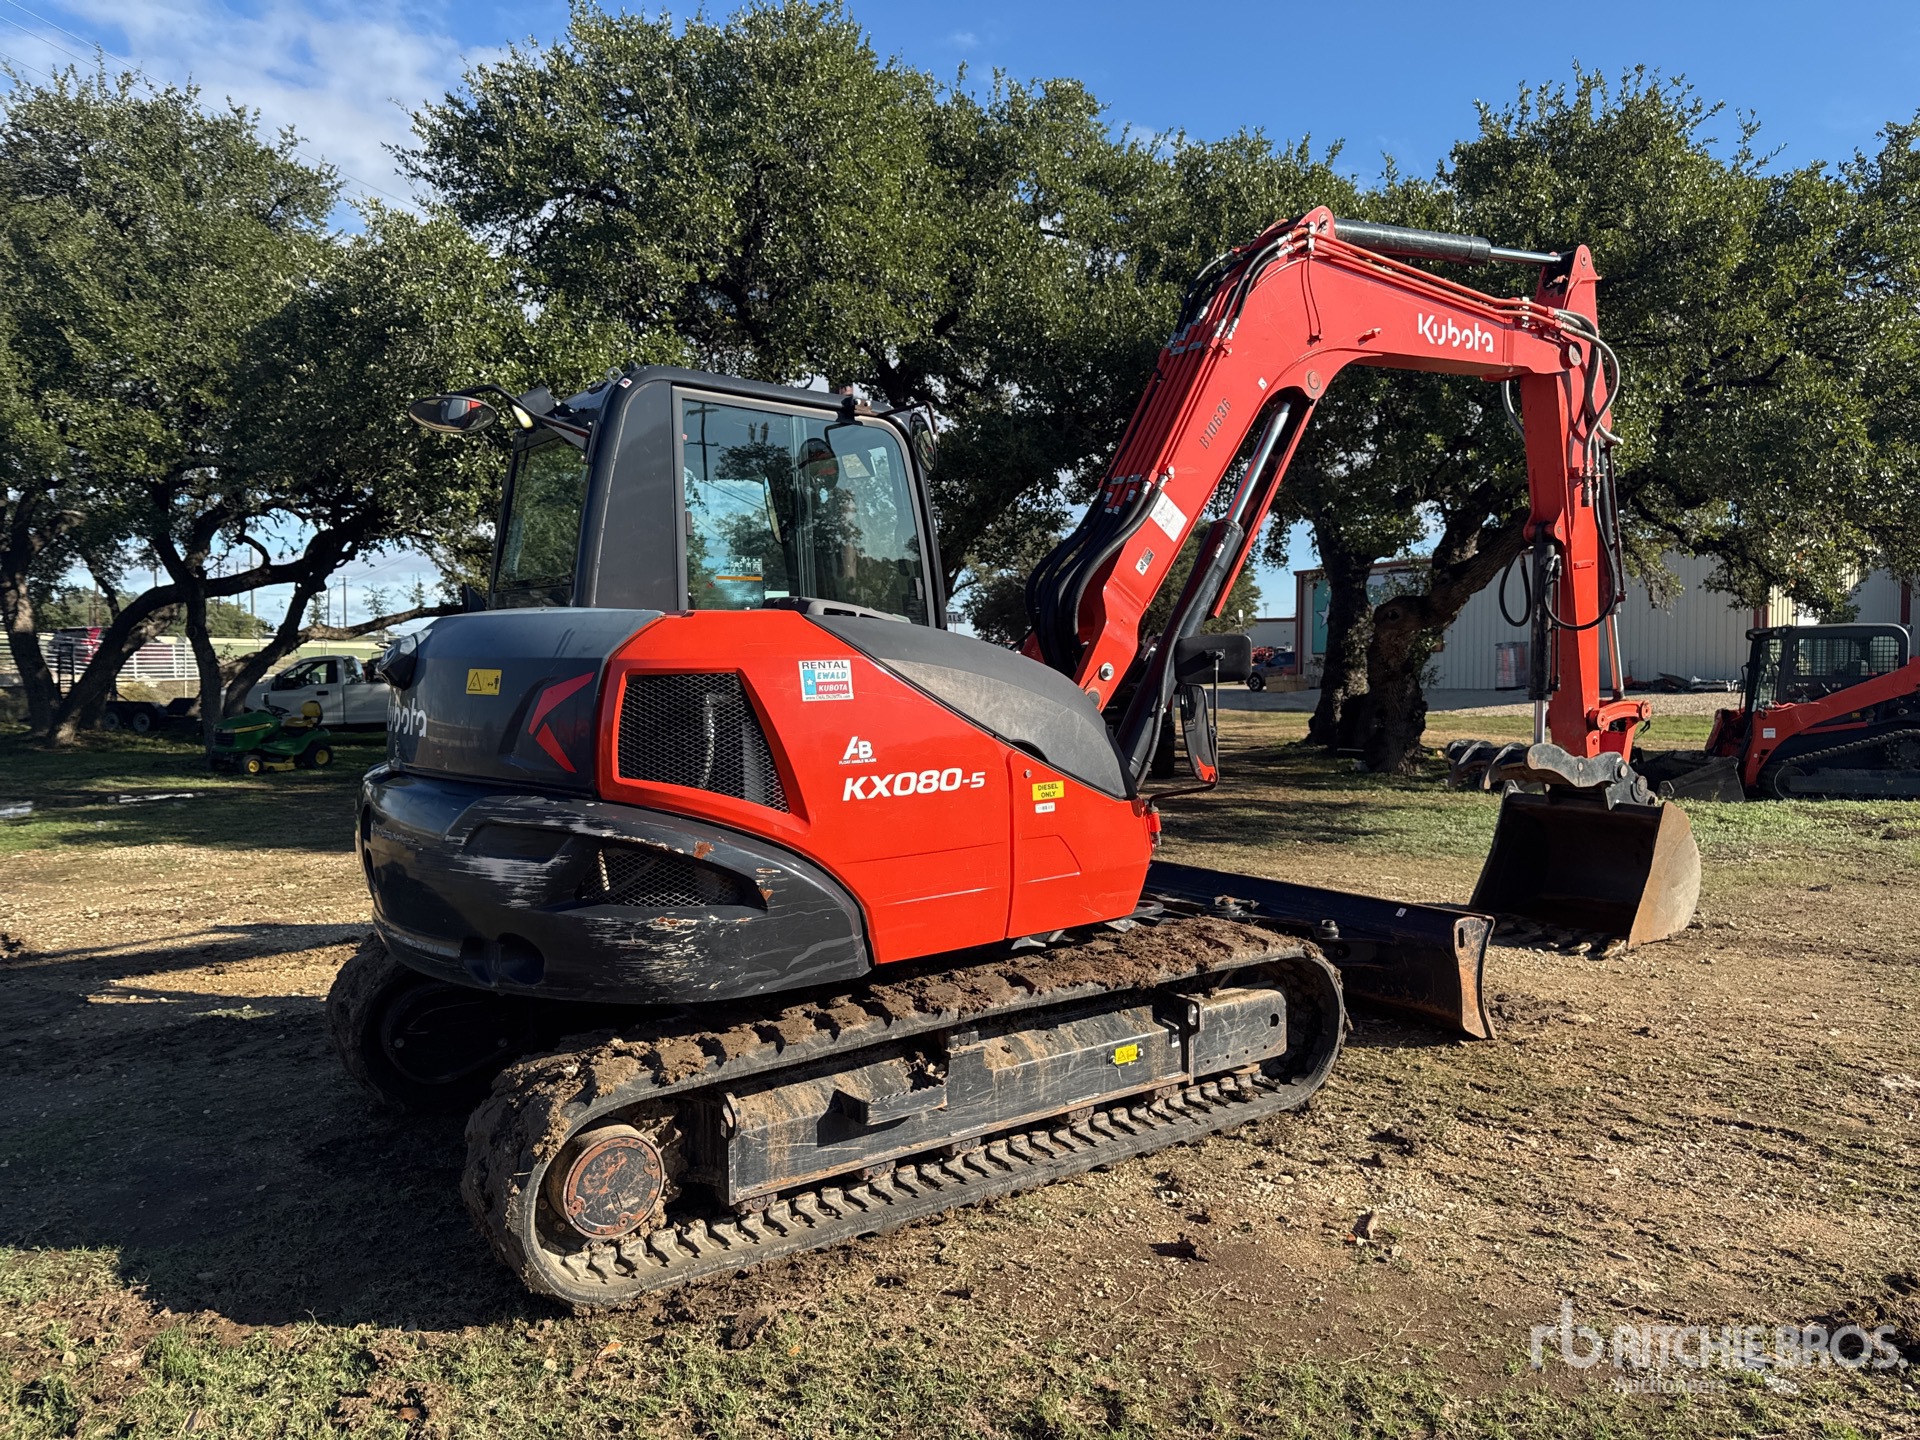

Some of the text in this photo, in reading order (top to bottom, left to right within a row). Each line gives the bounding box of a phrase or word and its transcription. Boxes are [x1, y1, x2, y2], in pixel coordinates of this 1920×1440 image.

[1417, 312, 1494, 353] Kubota
[1199, 398, 1232, 450] B10636
[802, 661, 848, 669] RENTAL
[816, 671, 847, 680] EWALD
[818, 684, 848, 692] KUBOTA
[387, 697, 428, 738] ubota
[842, 767, 986, 802] KX080-5
[1037, 783, 1058, 791] DIESEL
[1041, 791, 1056, 799] ONLY
